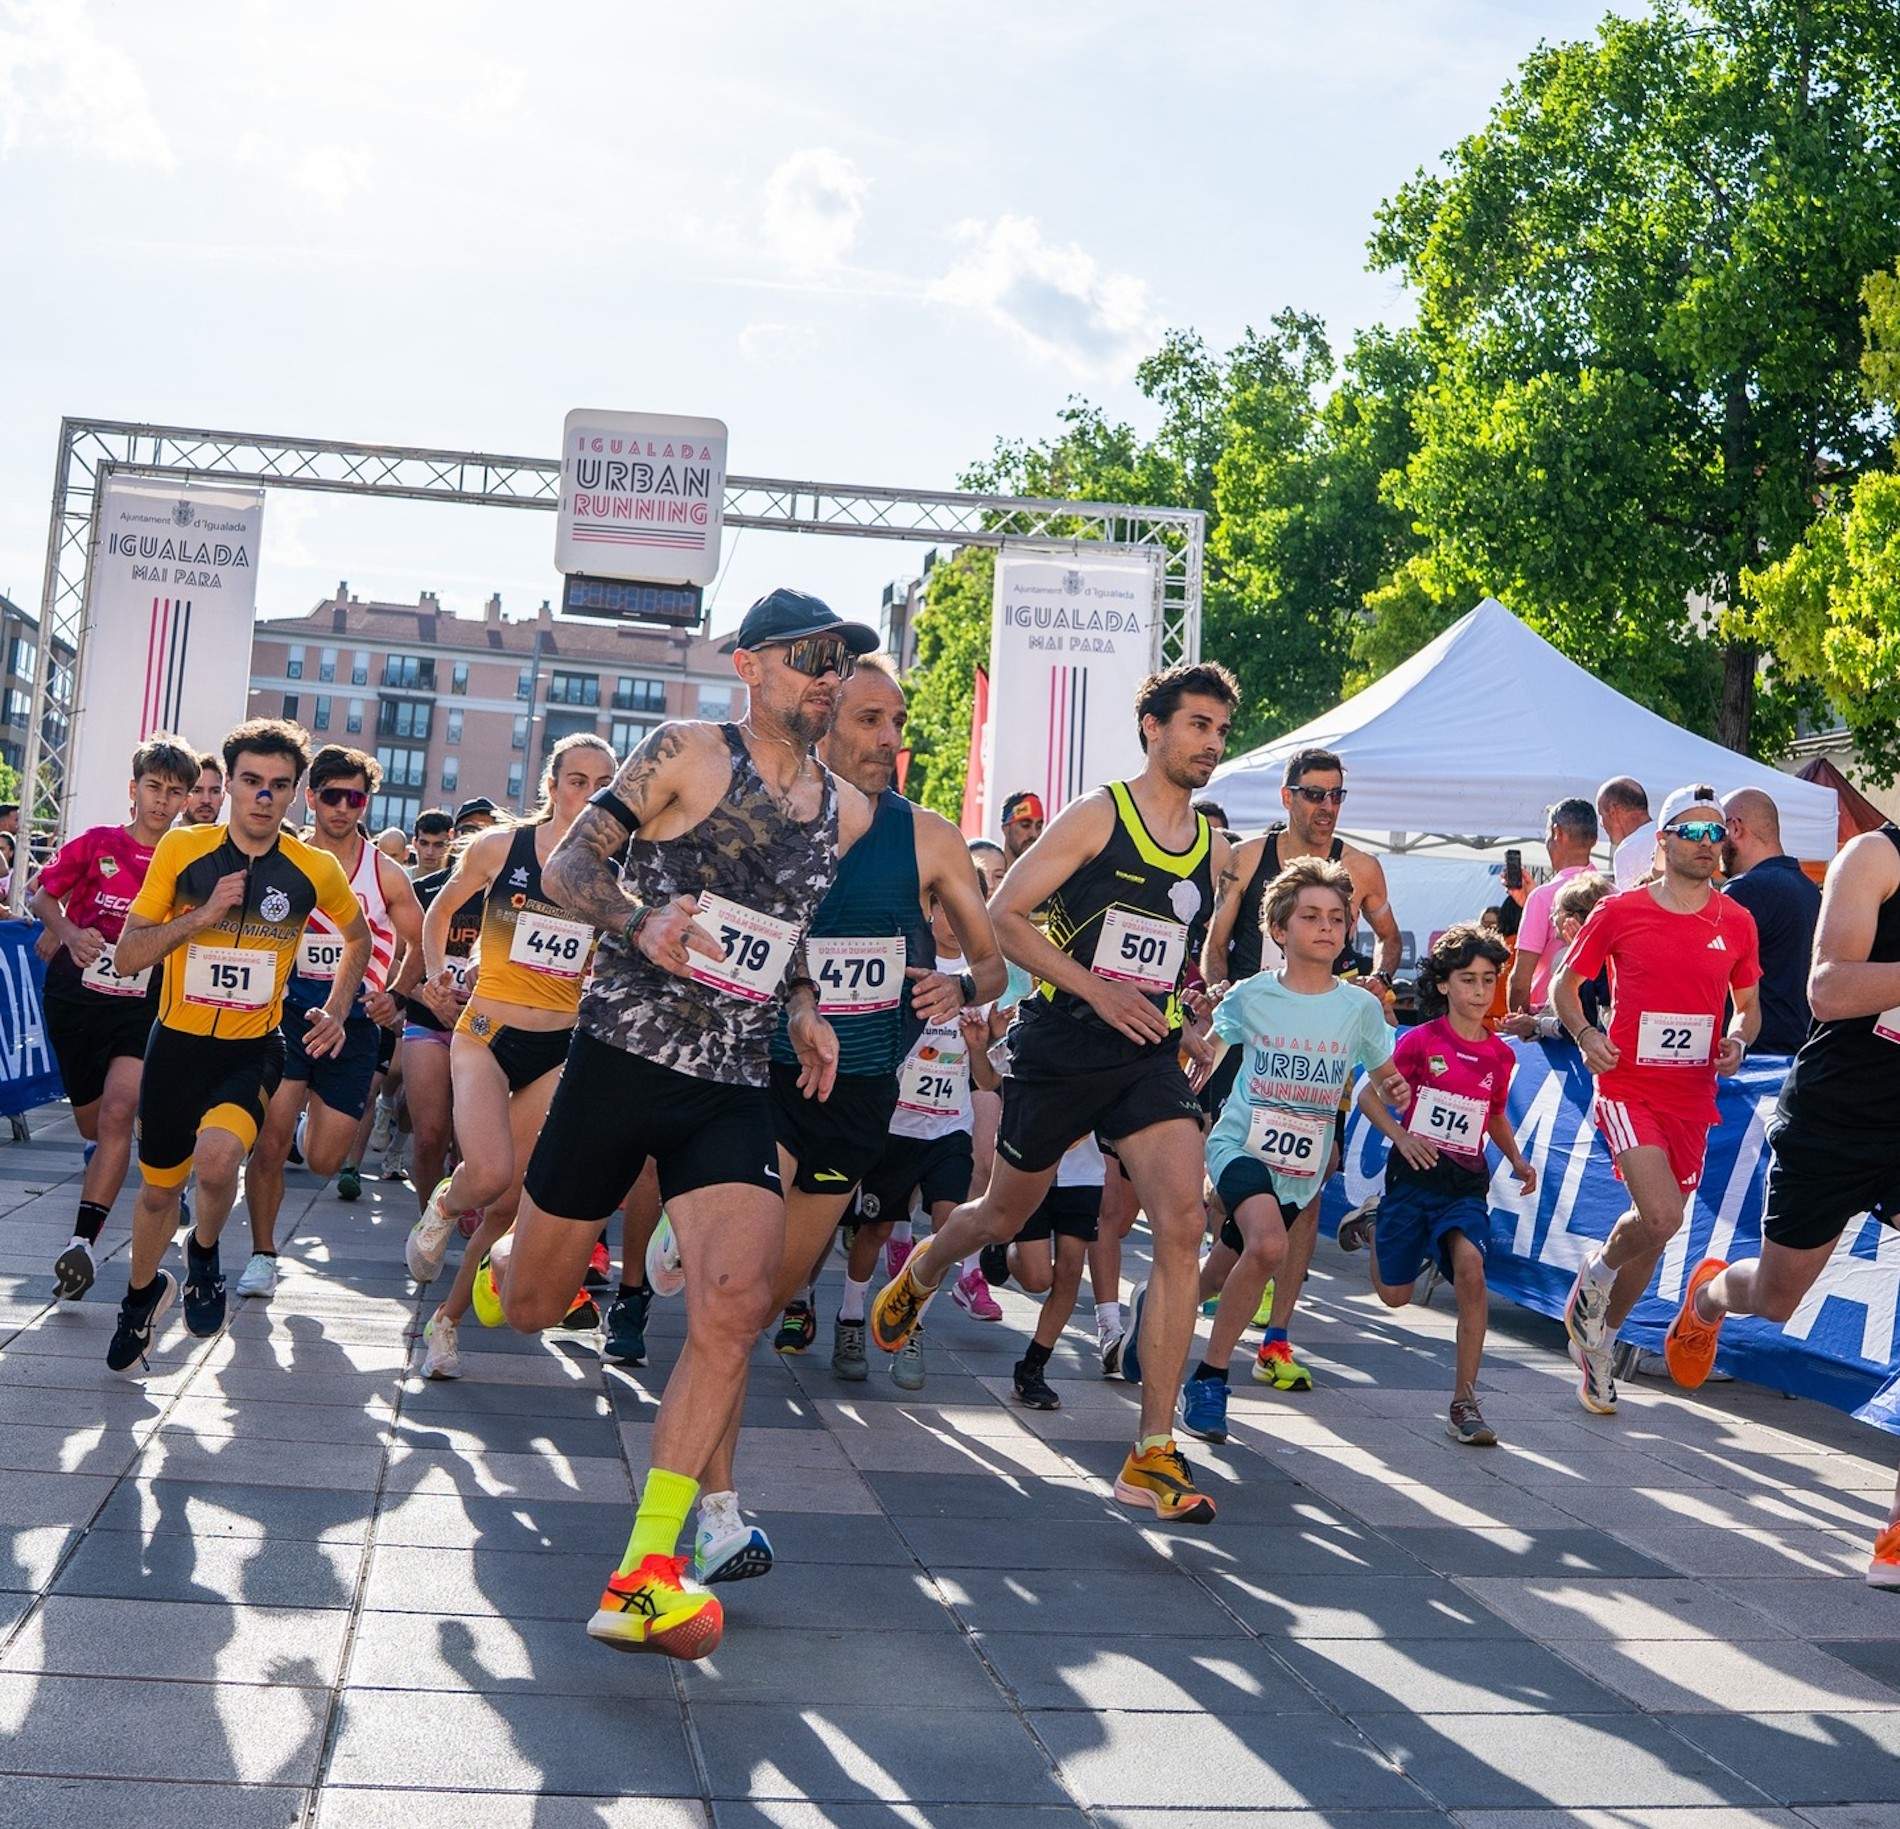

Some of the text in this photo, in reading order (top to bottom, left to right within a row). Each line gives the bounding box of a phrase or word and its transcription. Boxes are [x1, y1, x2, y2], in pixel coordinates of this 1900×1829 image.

[578, 437, 711, 460] IGUALADA
[576, 458, 710, 498] URBAN
[120, 511, 172, 526] Ajuntament
[573, 494, 708, 525] RUNNING
[108, 532, 250, 568] IGUALADA
[132, 564, 222, 589] MAI PARA
[1013, 584, 1062, 595] Ajuntament
[1005, 606, 1140, 634] IGUALADA
[1028, 635, 1116, 654] MAI PARA
[527, 930, 580, 960] 448
[720, 924, 770, 972] 319
[1120, 932, 1168, 966] 501
[210, 964, 250, 990] 151
[820, 958, 884, 988] 470
[1660, 1028, 1692, 1049] 22
[1254, 1051, 1346, 1084] URBAN
[916, 1075, 952, 1099] 214
[1430, 1105, 1468, 1135] 514
[1260, 1128, 1313, 1159] 206
